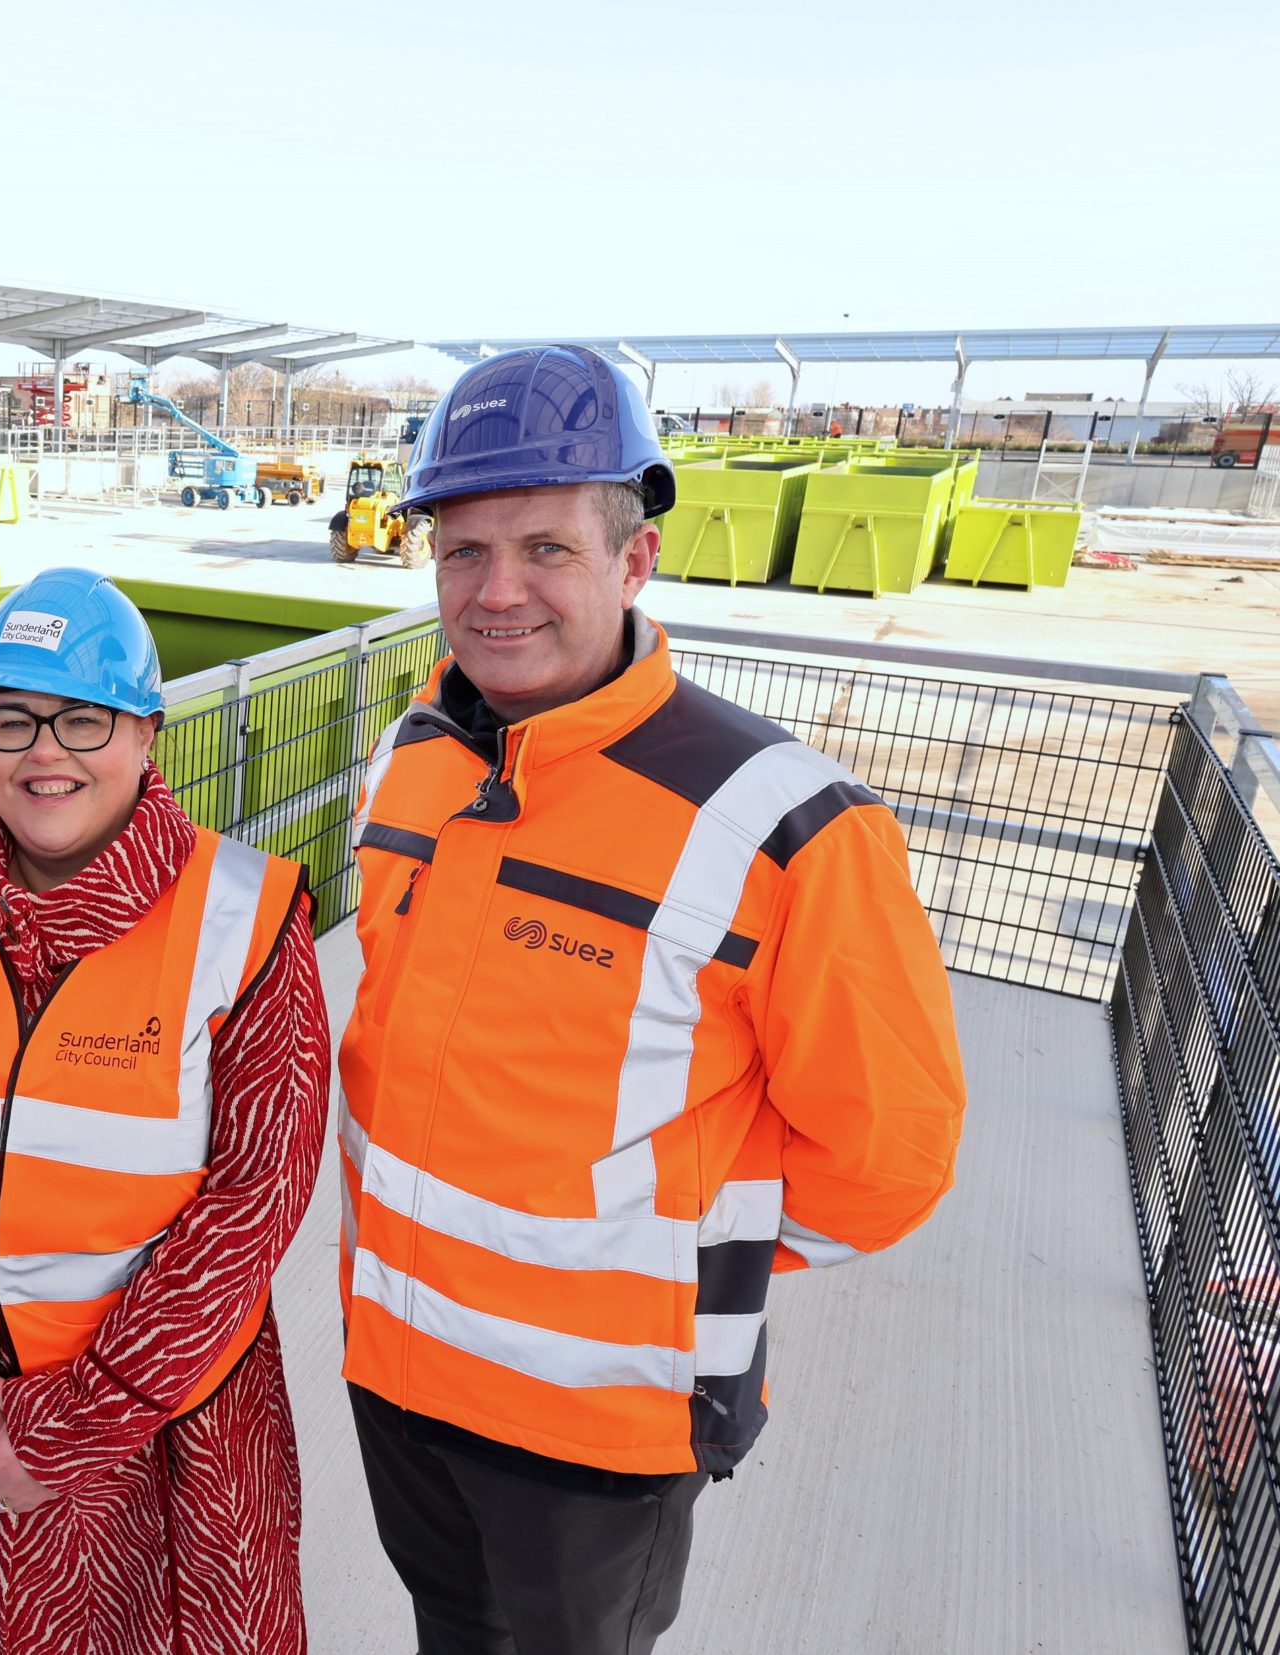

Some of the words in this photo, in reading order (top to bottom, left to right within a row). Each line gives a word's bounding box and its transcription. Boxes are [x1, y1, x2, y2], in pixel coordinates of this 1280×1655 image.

[1, 631, 15, 641] City
[15, 632, 44, 643] Council
[4, 622, 61, 639] Sunderland
[58, 1031, 161, 1055] Sunderland
[55, 1049, 83, 1067] City
[84, 1051, 137, 1070] Council
